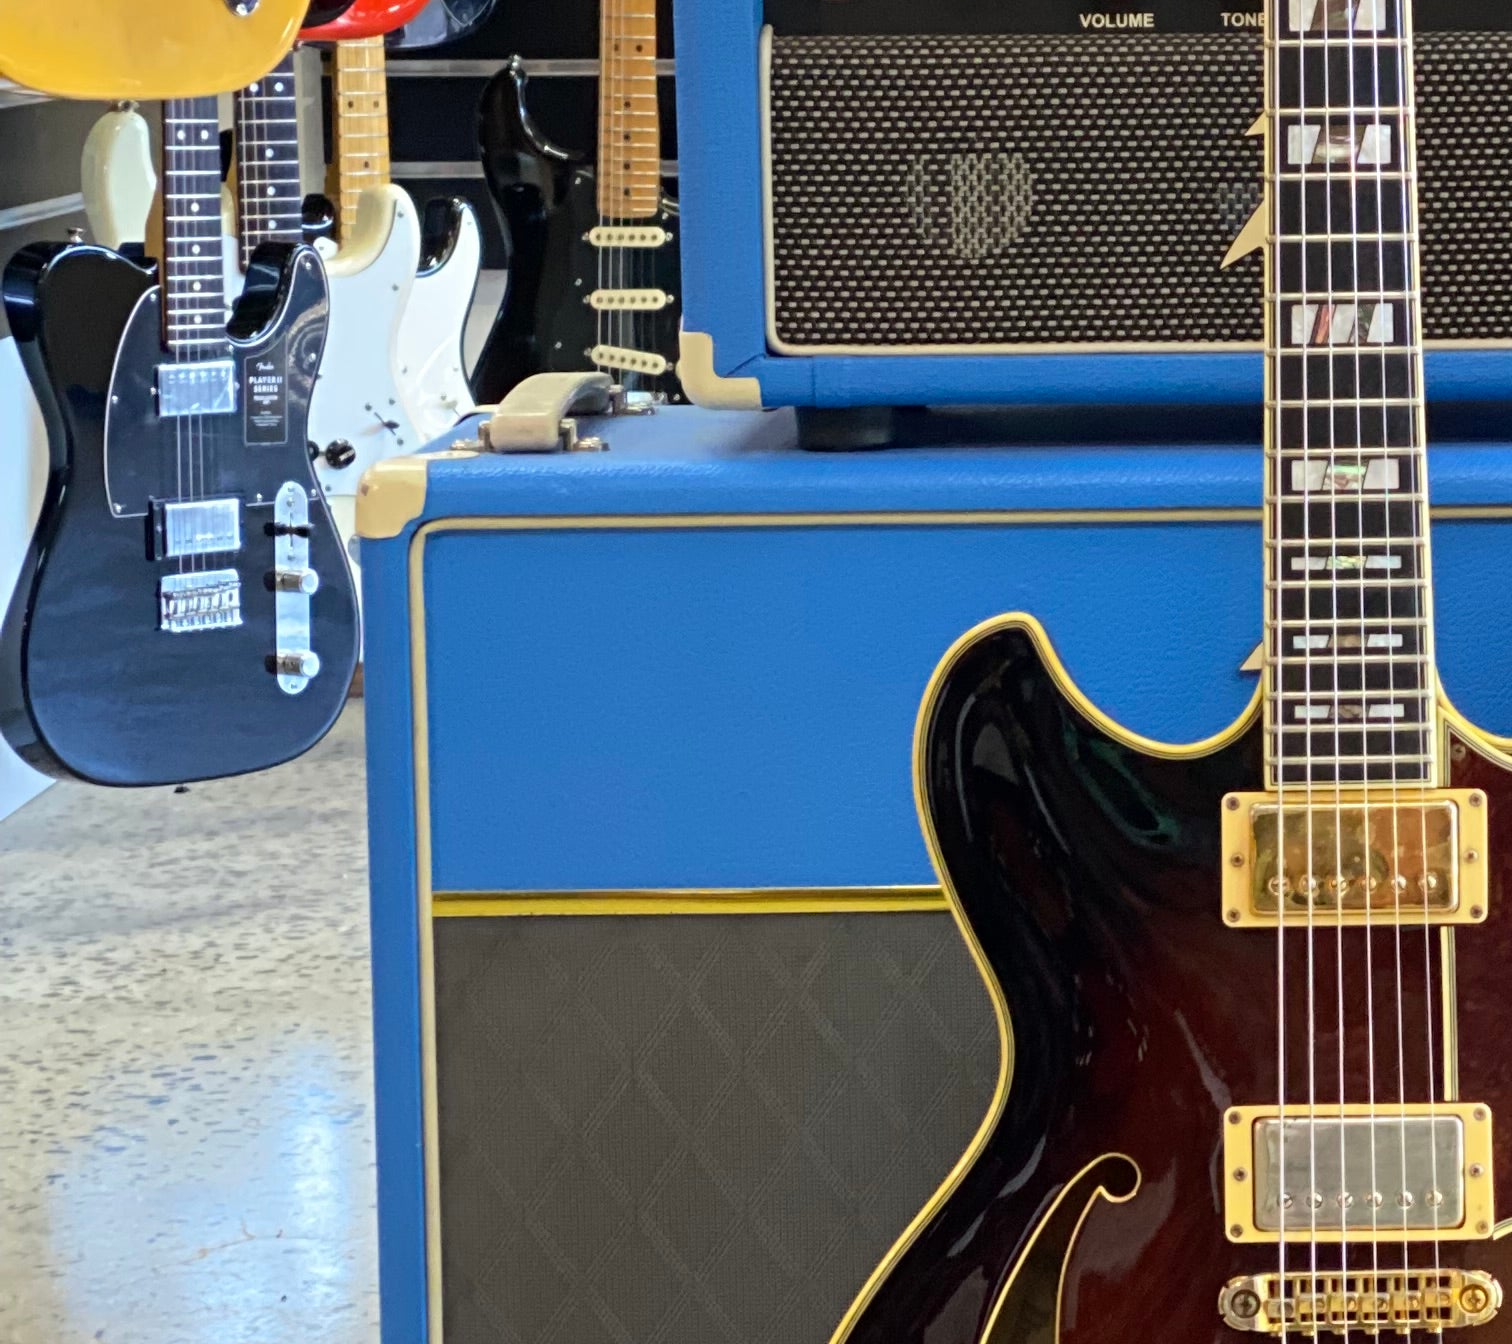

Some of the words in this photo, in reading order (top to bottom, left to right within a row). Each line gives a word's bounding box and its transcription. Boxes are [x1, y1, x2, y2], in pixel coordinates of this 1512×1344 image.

[1079, 13, 1156, 29] VOLUME
[1220, 12, 1265, 27] TONE
[248, 376, 276, 385] PLAYER
[253, 384, 279, 393] SERIES
